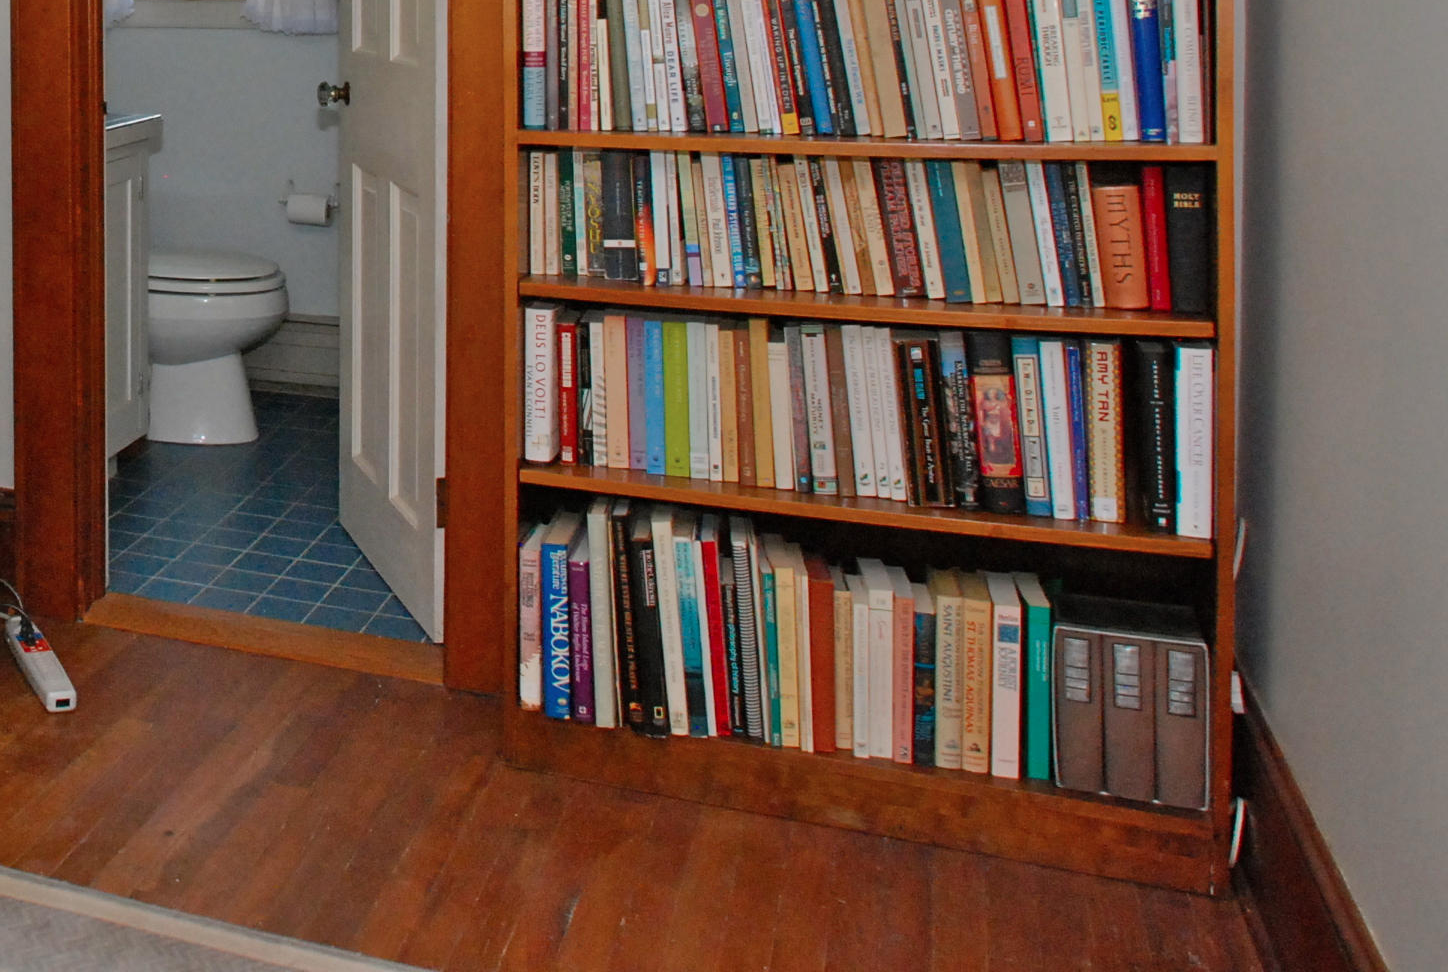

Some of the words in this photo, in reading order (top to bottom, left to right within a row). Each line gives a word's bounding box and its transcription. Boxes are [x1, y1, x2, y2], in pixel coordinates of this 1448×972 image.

[662, 2, 675, 19] Alice
[665, 22, 676, 45] Munro
[770, 17, 784, 52] WAKING
[788, 28, 796, 38] The
[1050, 25, 1062, 66] BREAKING
[1098, 10, 1109, 50] PERIODIC
[666, 50, 677, 79] DEAR
[722, 51, 738, 88] Enough
[776, 56, 786, 69] UP
[778, 72, 788, 81] IN
[1015, 57, 1035, 96] RUMI
[1101, 54, 1113, 82] TABLE
[670, 82, 680, 105] LIFE
[780, 84, 792, 110] EDEN
[636, 180, 645, 216] TEACHING
[638, 219, 646, 237] WITH
[1105, 194, 1135, 285] MYTHS
[535, 314, 547, 348] DEUS
[526, 364, 534, 389] EVAN
[536, 354, 547, 372] LO
[1096, 351, 1110, 385] AMY
[1191, 355, 1205, 379] LIFE
[956, 362, 966, 398] MARKING
[536, 379, 547, 419] VOLT!
[921, 406, 930, 417] The
[959, 399, 967, 412] THE
[1097, 390, 1111, 422] TAN
[1192, 382, 1205, 416] OVER
[1192, 417, 1206, 467] CANCER
[964, 455, 974, 472] FALL
[580, 602, 589, 615] The
[942, 604, 954, 636] SAINT
[550, 594, 571, 693] NABOKOV
[727, 623, 739, 662] philosophy
[965, 636, 976, 681] THOMAS
[730, 662, 739, 670] of
[941, 640, 954, 703] AUGUSTINE
[730, 671, 740, 695] history
[964, 684, 976, 734] AQUINAS
